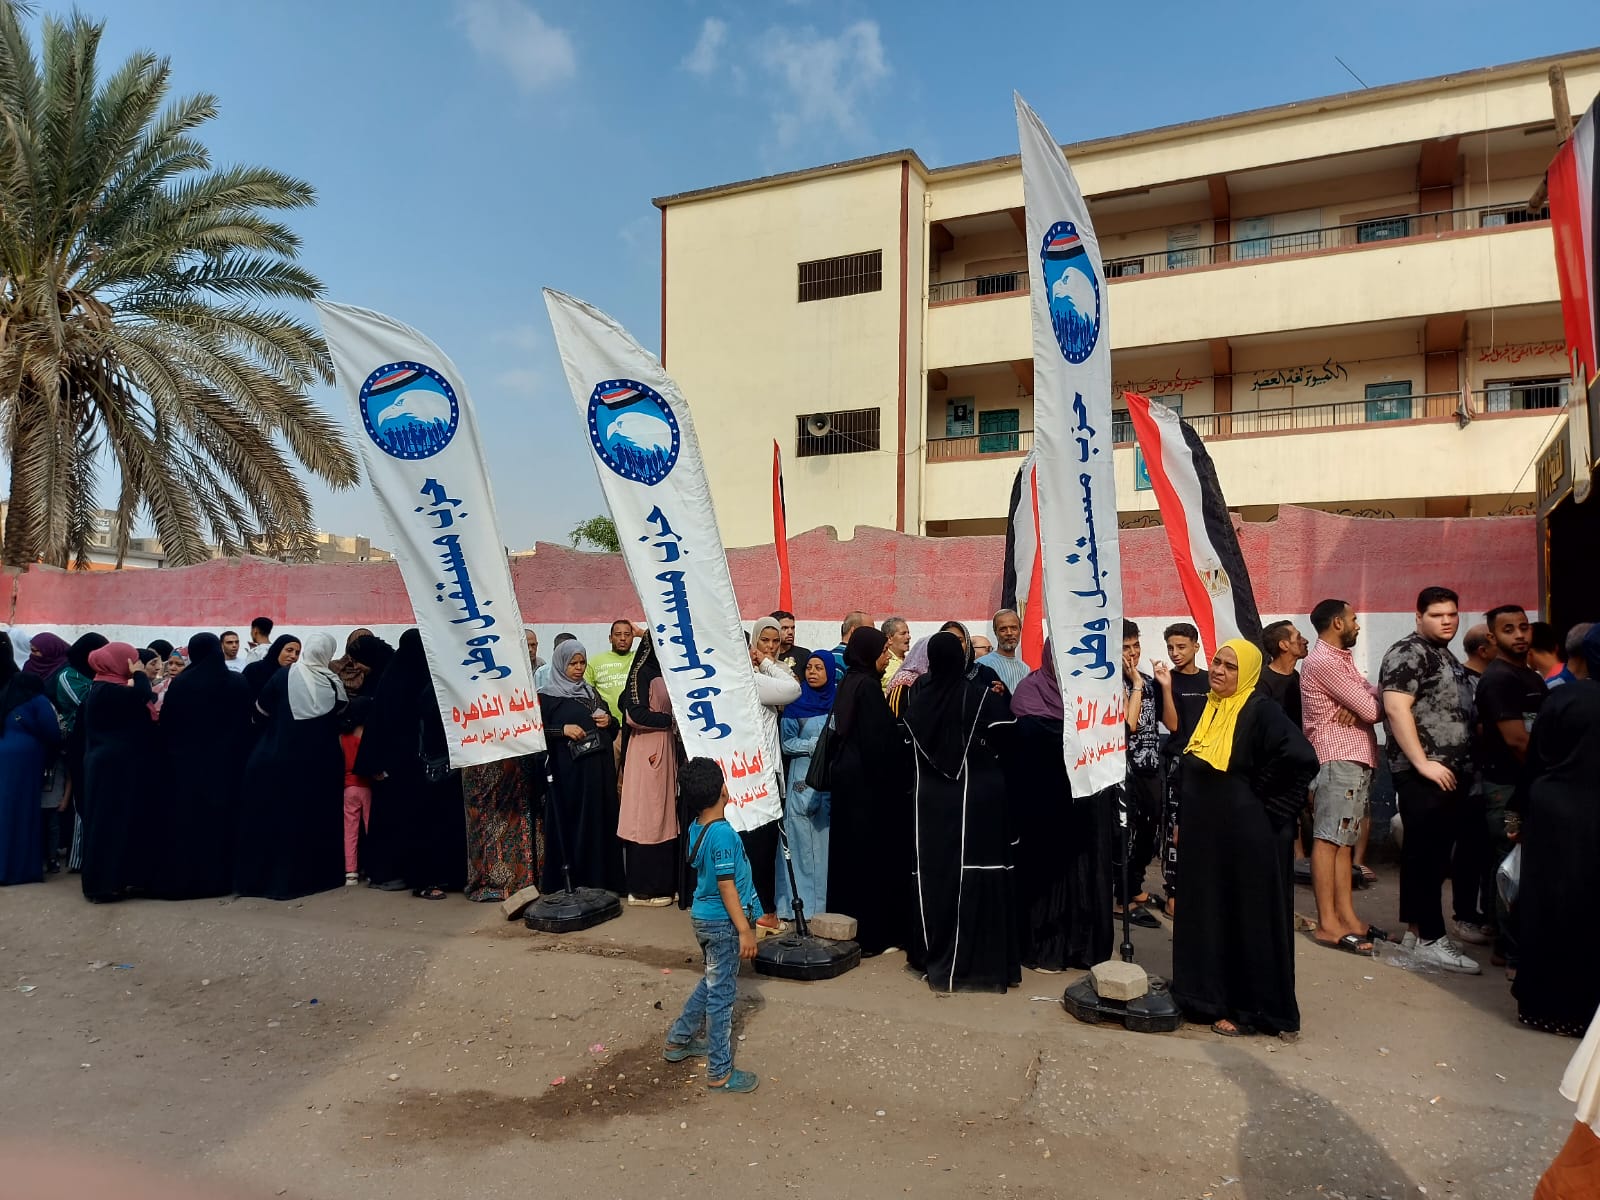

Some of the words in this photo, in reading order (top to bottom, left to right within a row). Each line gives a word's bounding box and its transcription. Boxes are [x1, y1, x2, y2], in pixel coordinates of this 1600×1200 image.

[1070, 391, 1099, 463] حزب
[415, 477, 468, 529] حزب
[638, 505, 689, 563] حزب
[1065, 473, 1108, 608] مستقبل
[433, 534, 496, 629] مستقبل
[655, 570, 717, 680] مستقبل
[1064, 617, 1115, 680] وطن
[463, 634, 512, 681] وطن
[480, 727, 497, 744] اجل
[499, 728, 511, 741] من
[686, 686, 733, 740] وطن
[461, 733, 478, 748] مصر
[731, 746, 764, 778] امانه
